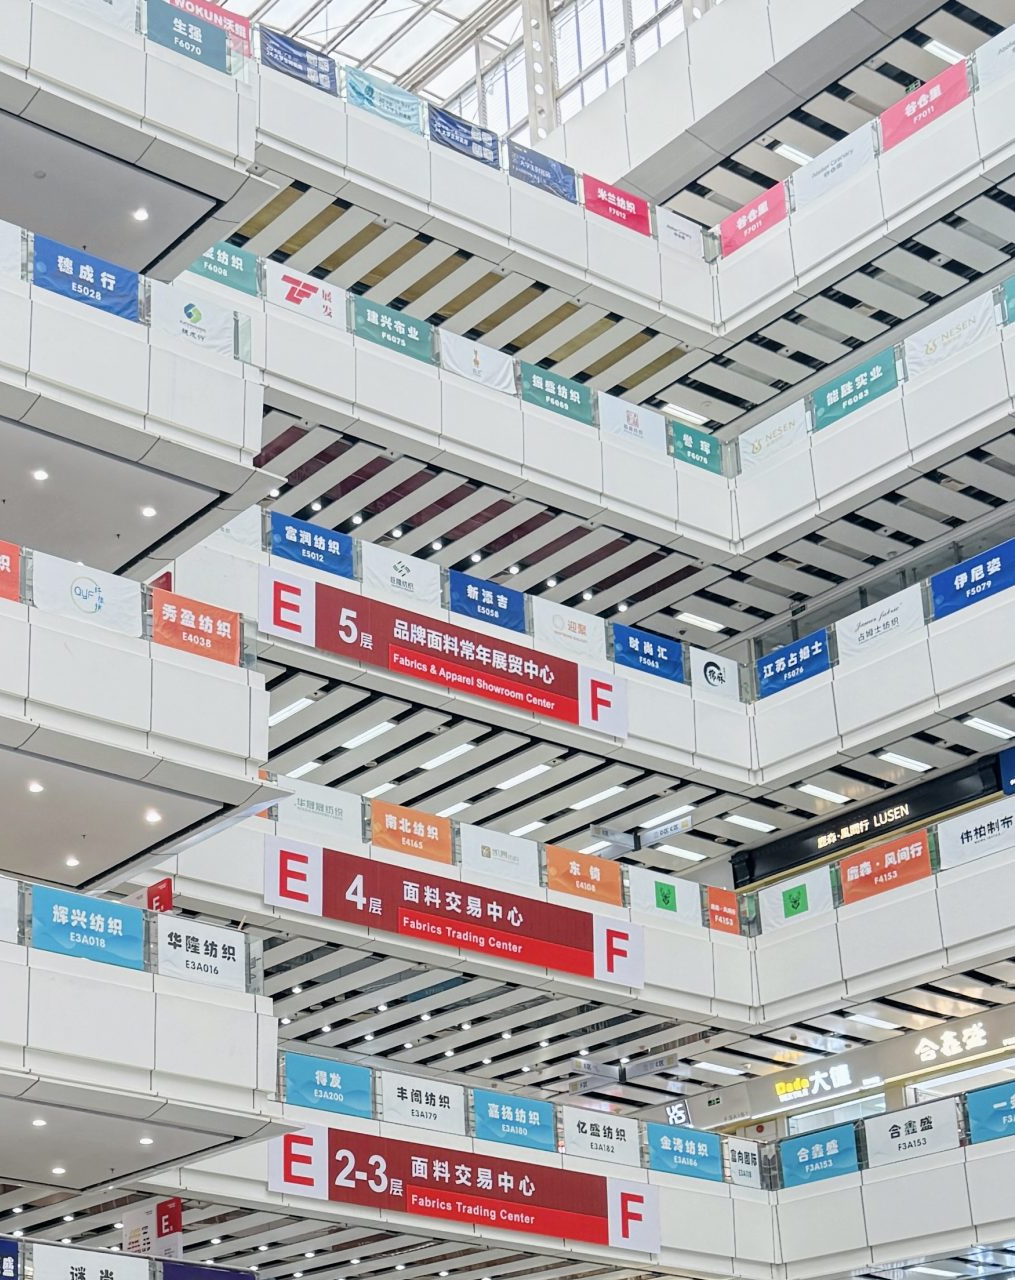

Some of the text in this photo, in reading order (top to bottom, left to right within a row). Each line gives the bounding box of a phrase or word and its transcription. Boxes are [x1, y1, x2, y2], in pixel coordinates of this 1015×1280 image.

[173, 18, 203, 44] 生强
[174, 37, 202, 56] F6070
[57, 255, 116, 291] 穗成行
[71, 282, 101, 300] E5028
[366, 308, 419, 341] 建兴布业
[285, 525, 340, 555] 富润纺织
[302, 549, 324, 563] E5012
[954, 557, 1002, 590] 伊尼姿
[966, 580, 992, 598] F5079
[162, 603, 232, 639] 秀盈纺织
[273, 581, 301, 633] E
[393, 618, 555, 685] 品牌面料常年展贸中心
[628, 636, 668, 660] 时尚汇
[763, 640, 822, 679] 江苏占姆士
[393, 653, 555, 710] Fabrics & Apparel Showroom Center
[591, 679, 613, 721] F
[385, 814, 439, 841] 南北纺织
[873, 804, 909, 827] LUSEN
[960, 815, 1013, 845] 伟柏制布
[279, 849, 309, 903] E
[402, 880, 524, 928] 面料交易中心
[52, 904, 124, 936] 辉兴纺织
[69, 932, 106, 948] E3A018
[167, 931, 236, 963] 华隆纺织
[403, 917, 523, 955] Fabrics Trading Center
[606, 929, 629, 973] F
[185, 959, 219, 975] E3A016
[315, 1069, 341, 1089] 得发
[314, 1089, 344, 1102] E3A200
[411, 1109, 437, 1120] E3A179
[576, 1120, 626, 1142] 亿盛纺织
[898, 1137, 927, 1151] F3A153
[284, 1134, 314, 1187] E
[590, 1142, 615, 1154] E3A182
[334, 1149, 404, 1197] 2-3层
[411, 1156, 535, 1197] 面料交易中心
[805, 1159, 833, 1173] F3A153
[411, 1195, 535, 1224] Fabrics Trading Center
[620, 1192, 644, 1239] F
